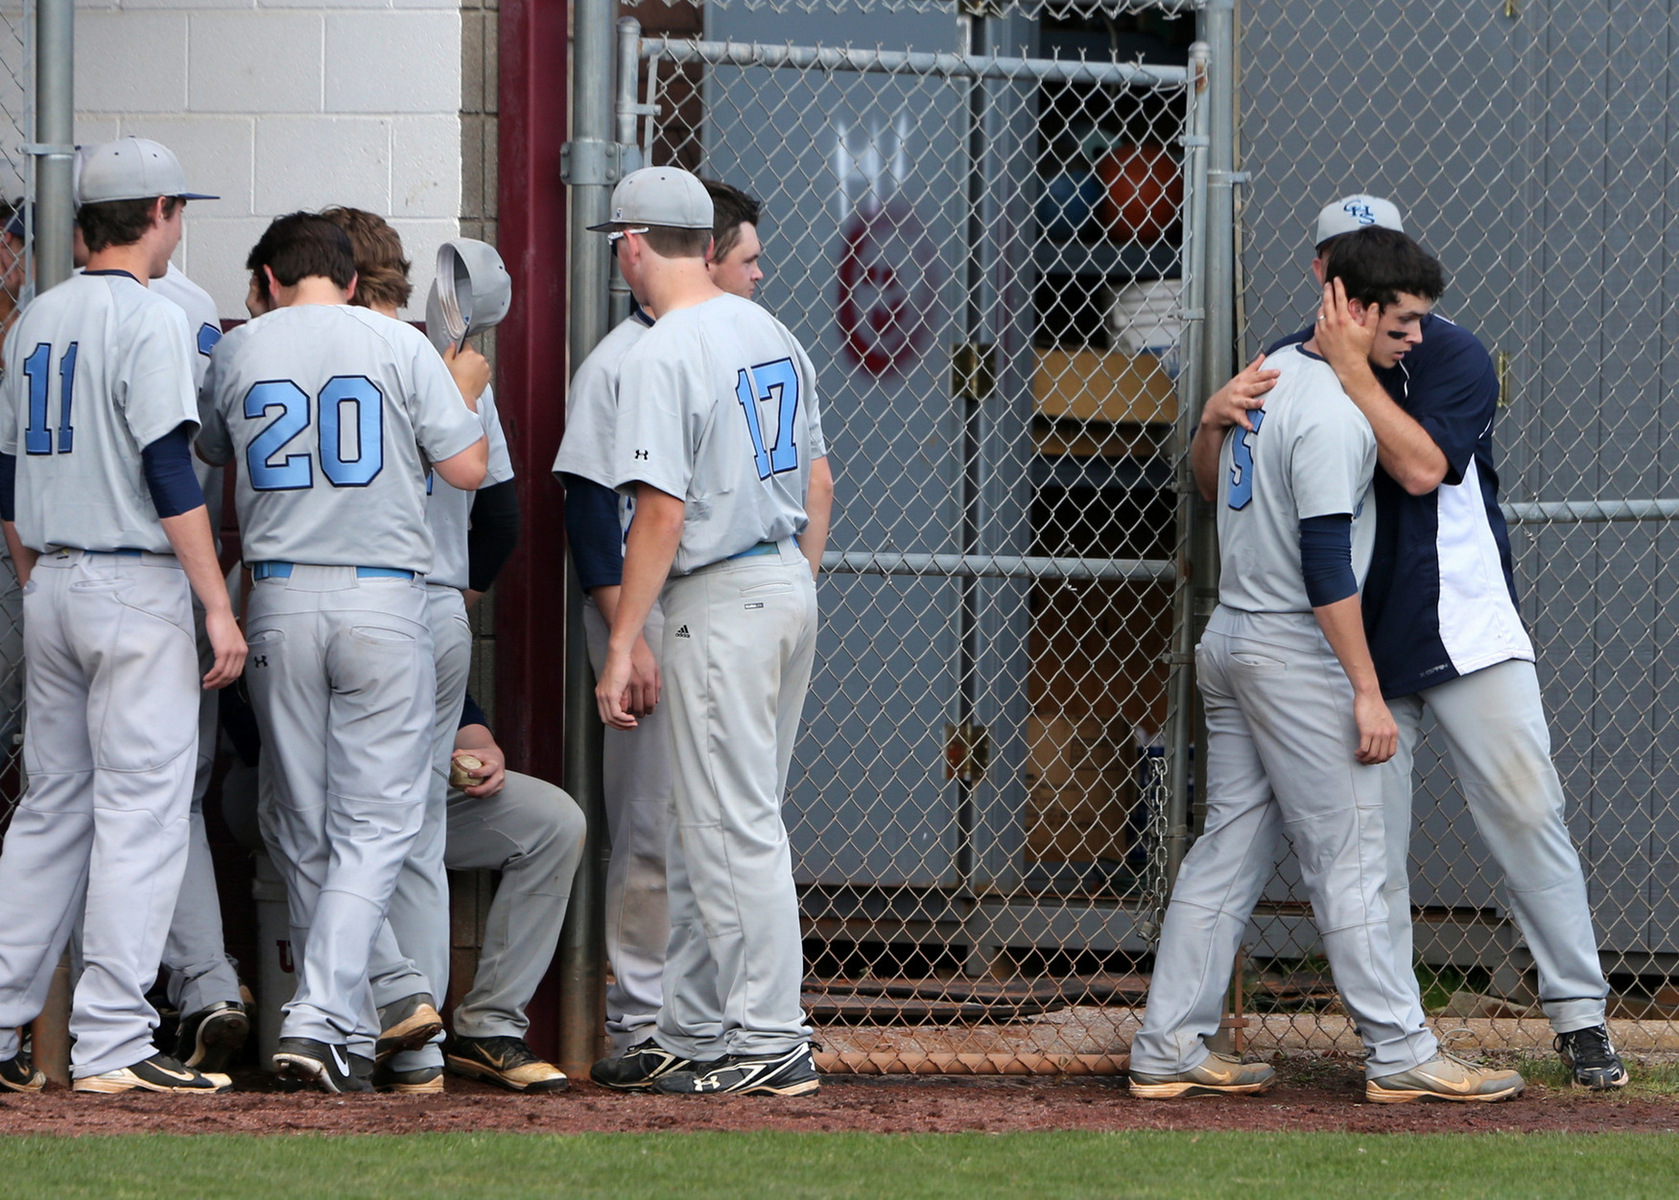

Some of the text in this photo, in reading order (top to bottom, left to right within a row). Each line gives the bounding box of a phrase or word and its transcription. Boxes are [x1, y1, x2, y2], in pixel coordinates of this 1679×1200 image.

[23, 341, 78, 456] 11
[243, 375, 384, 491] 20
[735, 357, 799, 482] 17
